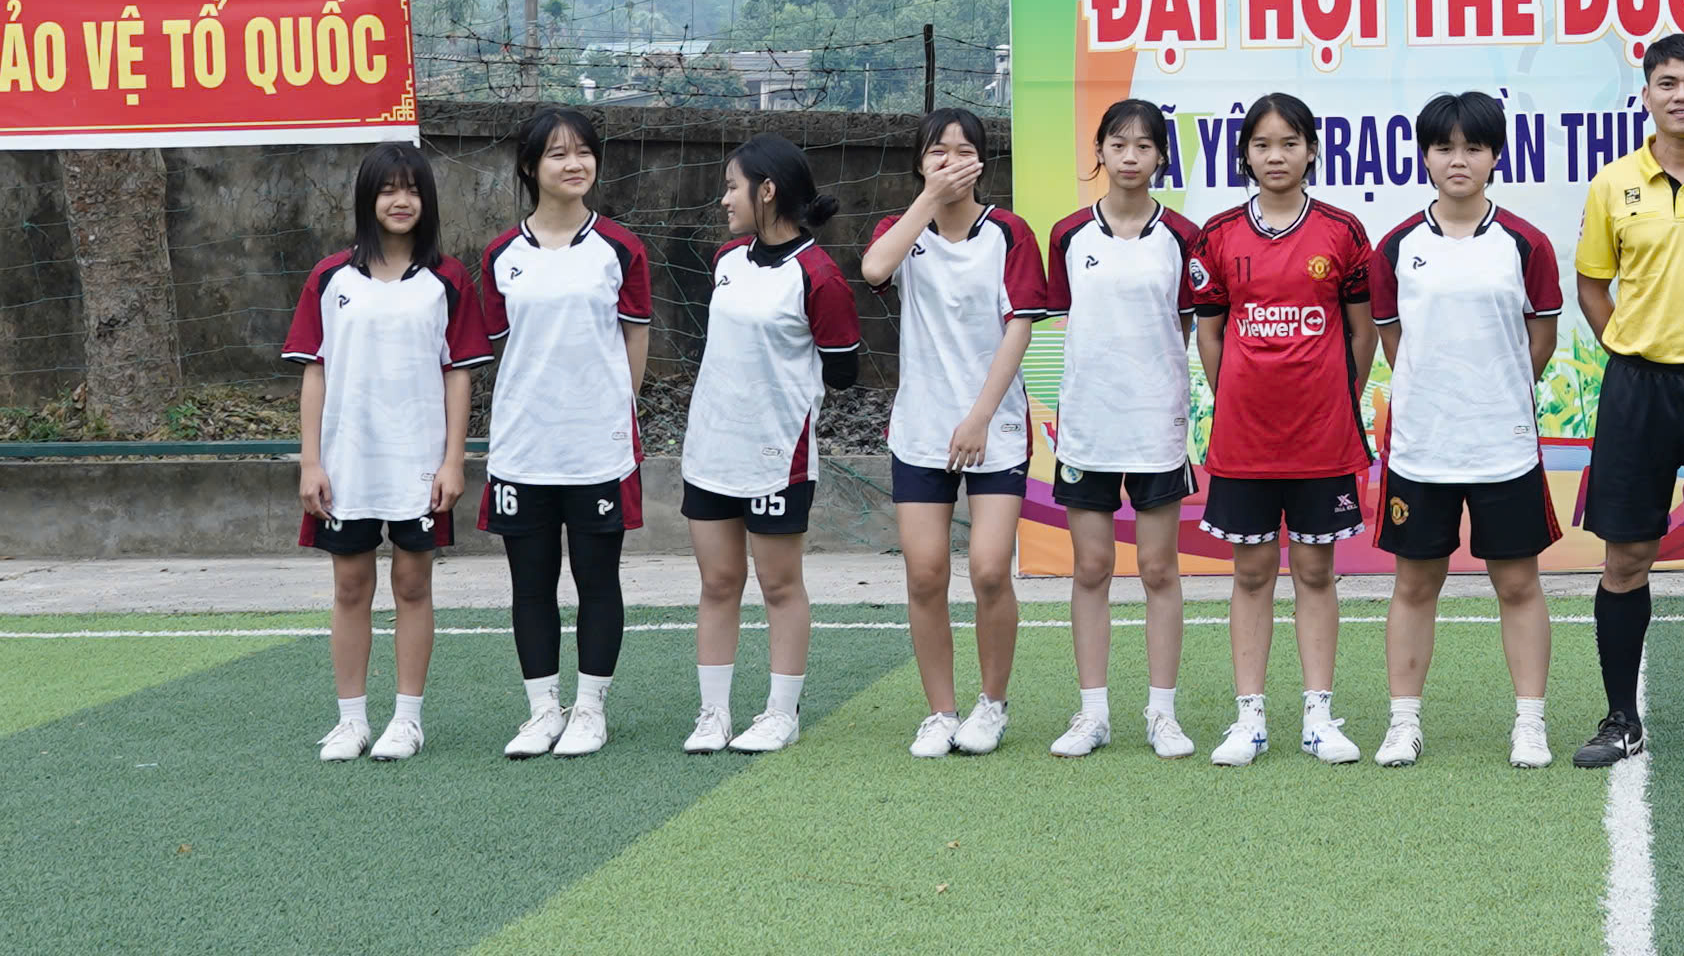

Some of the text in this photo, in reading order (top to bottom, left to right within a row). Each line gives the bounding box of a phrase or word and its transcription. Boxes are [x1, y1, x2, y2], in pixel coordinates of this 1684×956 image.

[82, 4, 147, 106] VỆ
[1150, 104, 1184, 189] Ã
[1197, 102, 1250, 188] YÊ
[1234, 255, 1251, 284] 11
[1244, 302, 1300, 322] Team
[1236, 318, 1299, 338] Viewer
[494, 482, 518, 516] 16
